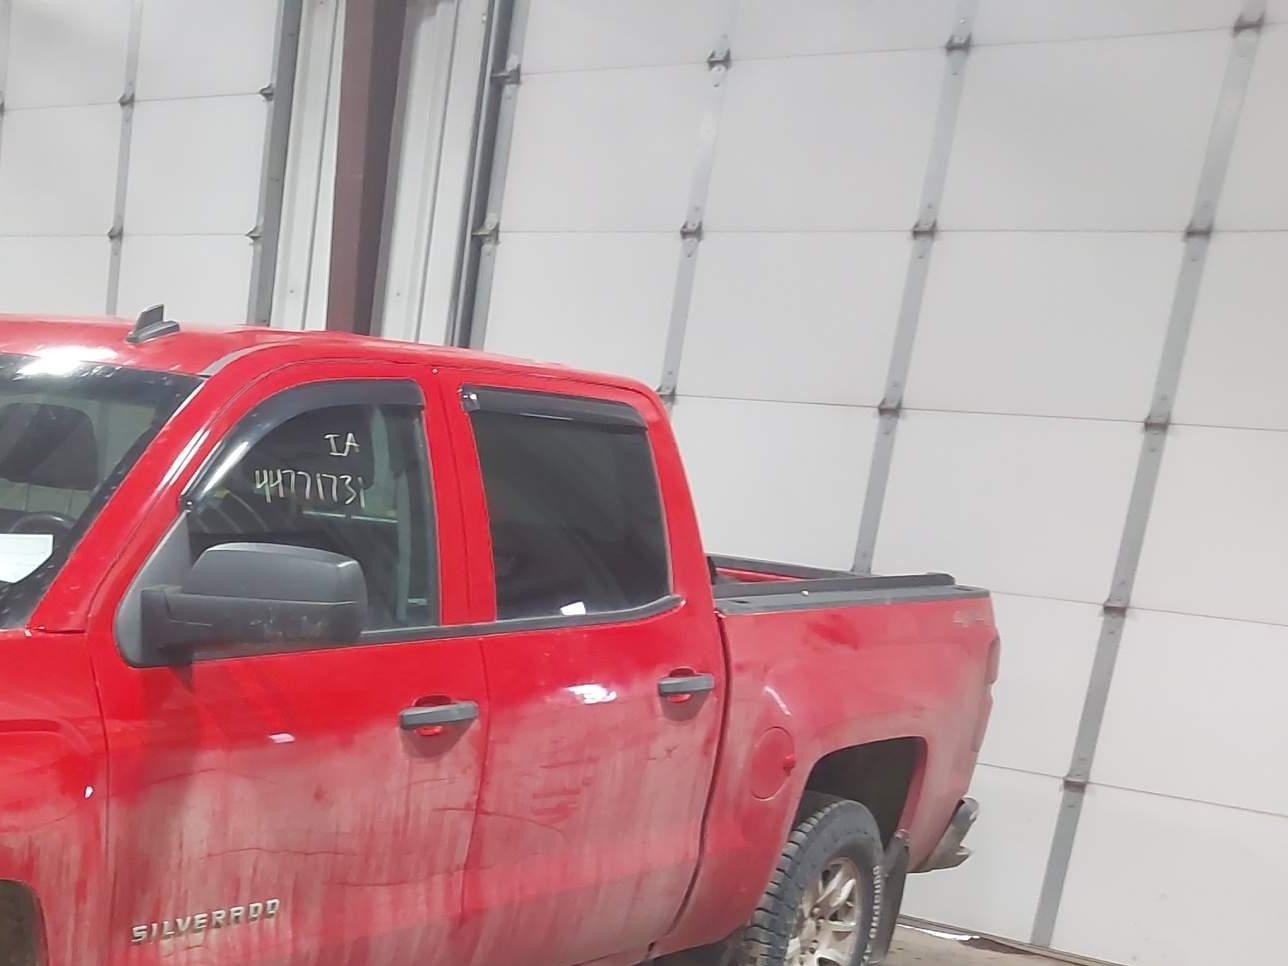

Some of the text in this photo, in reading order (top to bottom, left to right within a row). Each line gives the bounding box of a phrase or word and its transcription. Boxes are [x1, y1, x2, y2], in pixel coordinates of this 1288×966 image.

[323, 431, 361, 457] IA
[253, 469, 366, 508] 44771731
[130, 897, 281, 943] SILVERADO
